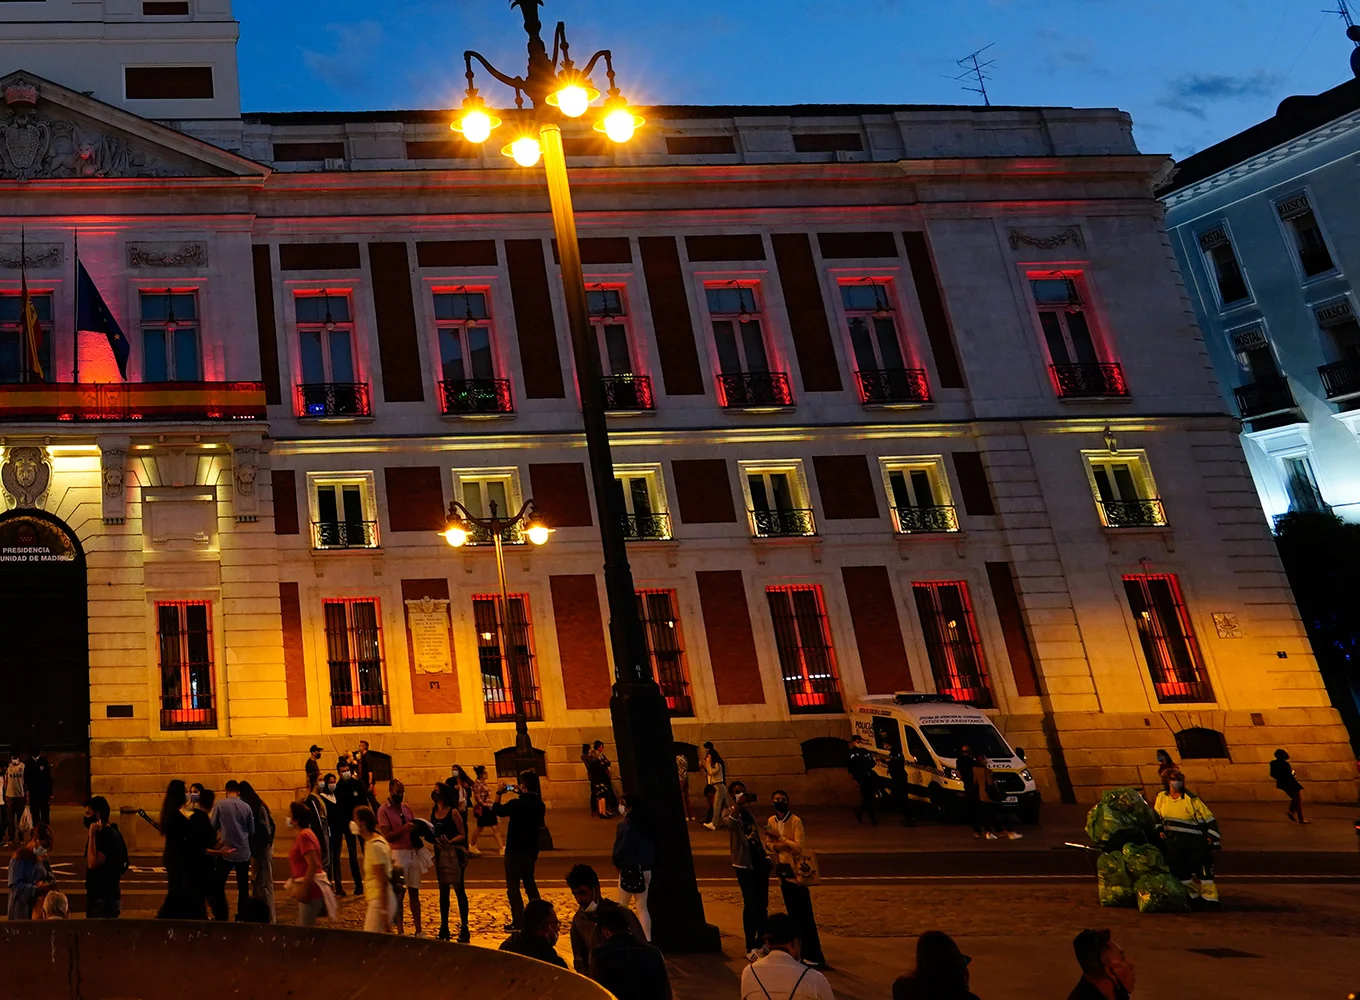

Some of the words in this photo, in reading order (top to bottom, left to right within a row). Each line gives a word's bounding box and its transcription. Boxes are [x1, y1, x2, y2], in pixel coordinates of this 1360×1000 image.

[1278, 196, 1308, 216] RIESCO
[1198, 228, 1226, 247] HOSTAL
[1317, 303, 1350, 322] RIESCO
[1233, 330, 1262, 348] HOSTAL
